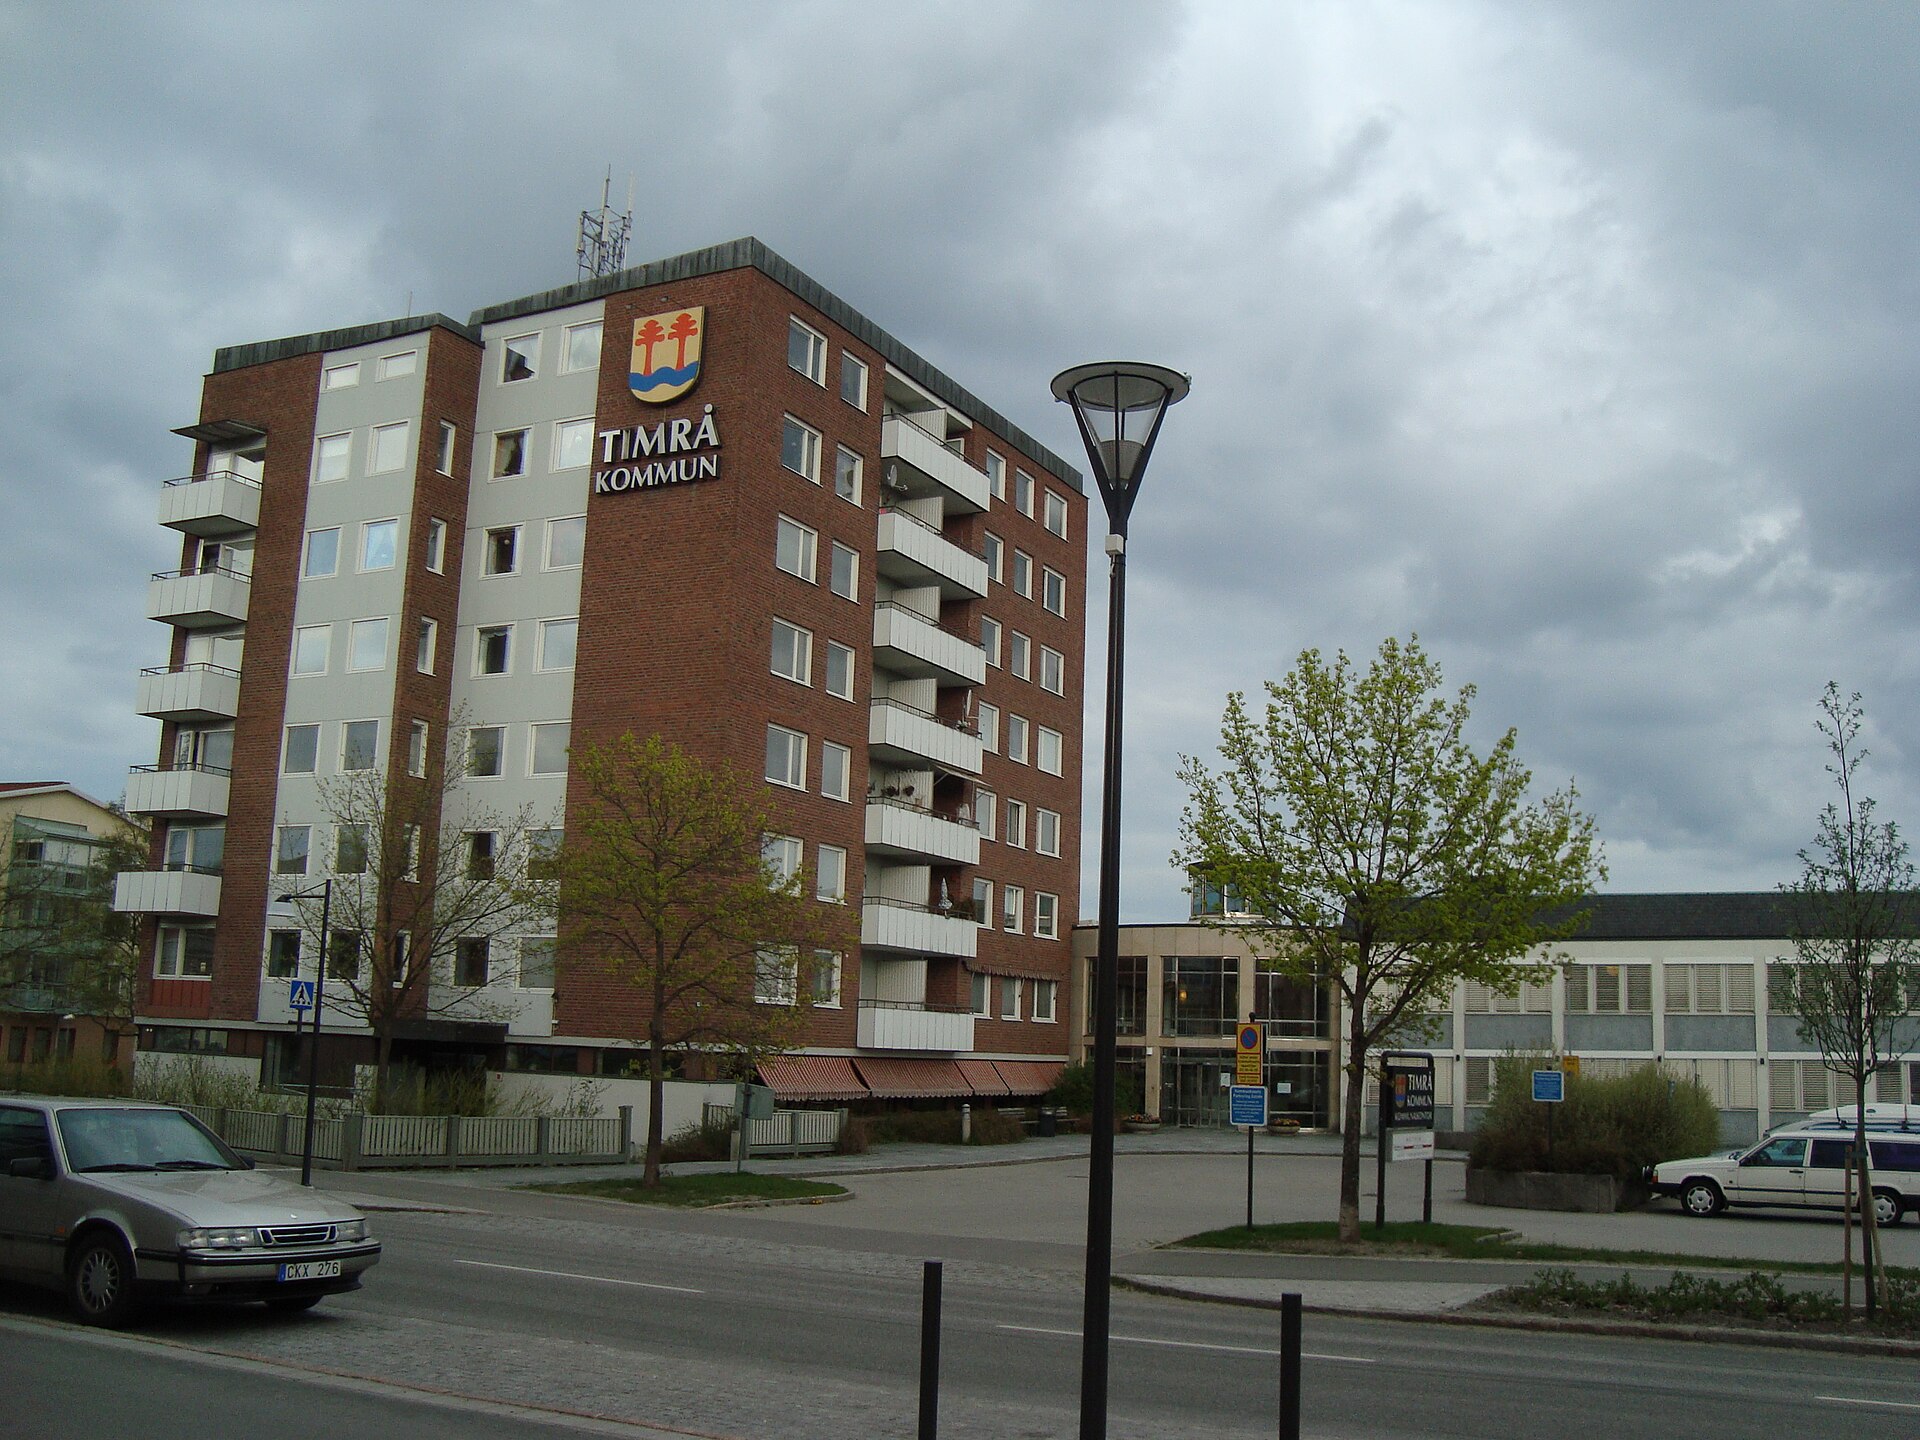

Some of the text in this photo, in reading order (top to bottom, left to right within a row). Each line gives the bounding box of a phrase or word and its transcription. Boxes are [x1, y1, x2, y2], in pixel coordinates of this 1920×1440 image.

[599, 403, 720, 463] TIMRÅ
[595, 454, 718, 494] KOMMUN
[1408, 1072, 1433, 1091] TIMRÅ
[1407, 1095, 1433, 1107] KOMMUN
[287, 1262, 339, 1279] CKX 276
